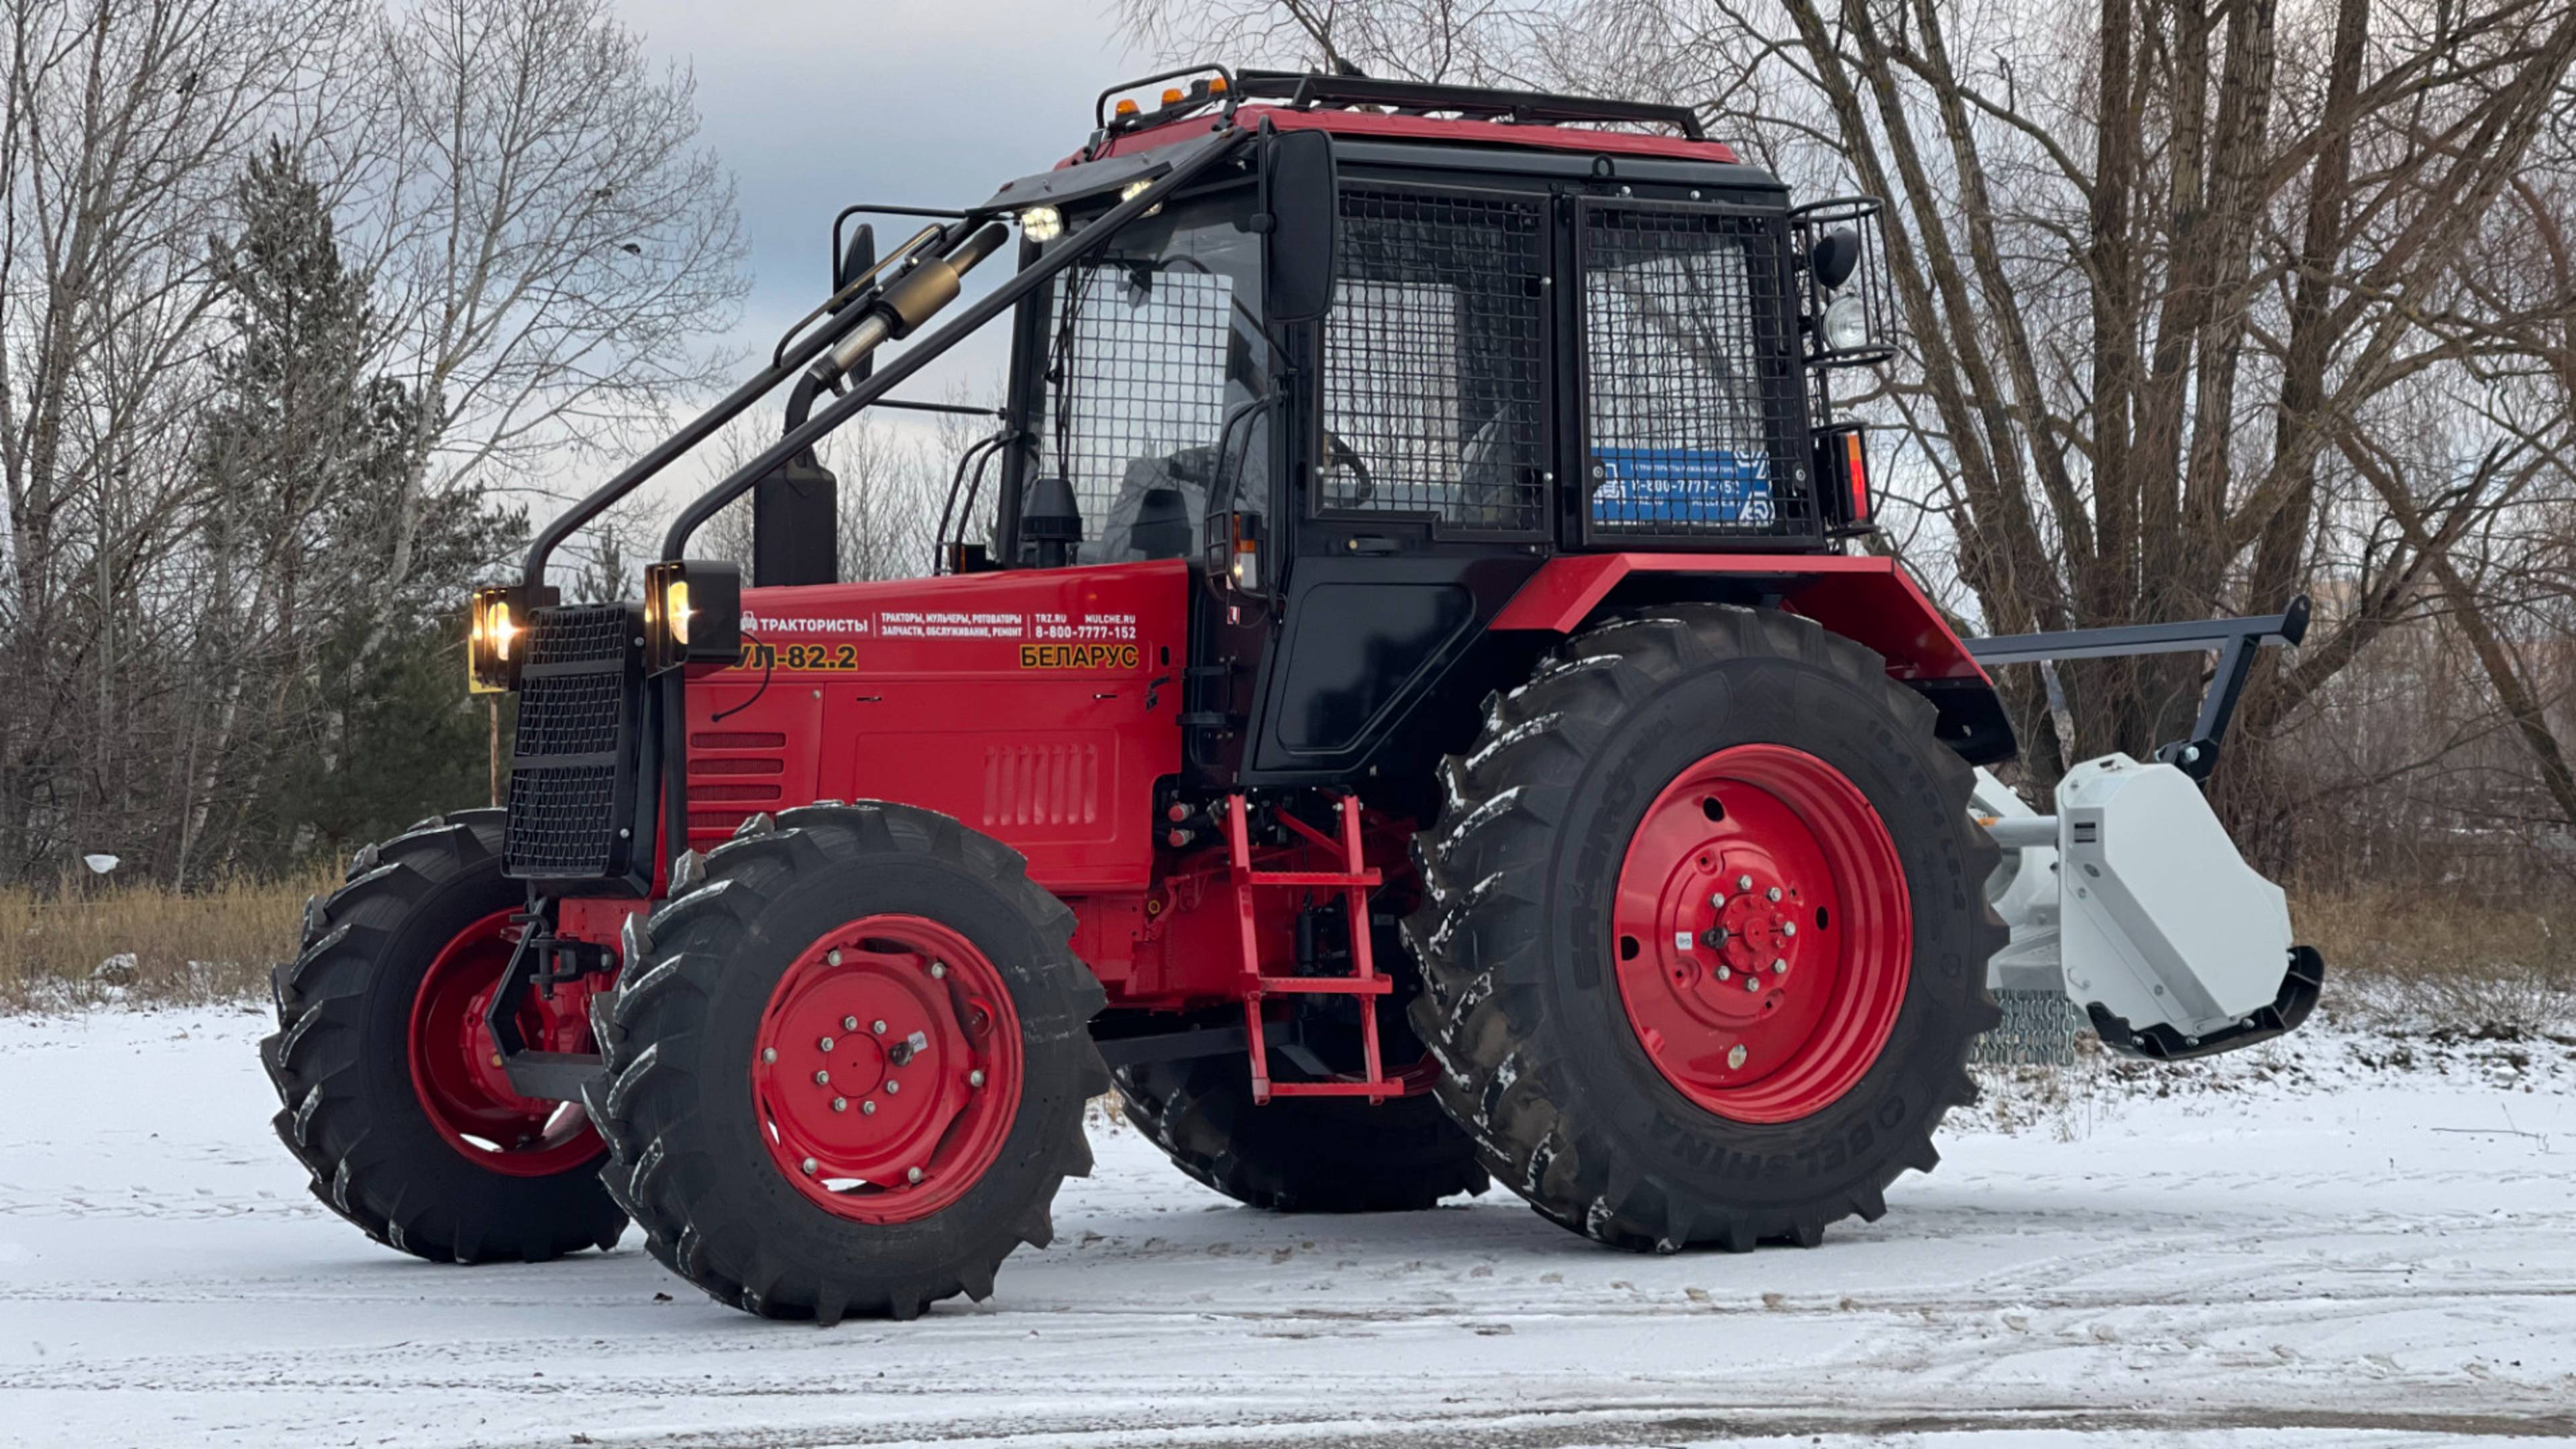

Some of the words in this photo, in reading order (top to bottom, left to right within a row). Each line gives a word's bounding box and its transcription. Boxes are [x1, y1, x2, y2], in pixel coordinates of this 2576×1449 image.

[881, 612, 925, 624] ТРАКТОРЫ,
[926, 613, 971, 625] МУЛЬЧЕРЫ,
[973, 614, 1022, 624] РОТОВАТОРЫ
[1034, 614, 1067, 623] TRZ.RU
[1085, 614, 1136, 624] MULCHE.RU
[760, 619, 868, 632] ТРАКТОРИСТЫ
[881, 625, 925, 637] ЗАПЧАСТИ,
[992, 627, 1022, 637] РЕМОНТ
[1035, 626, 1136, 639] 8-800-7777-152
[1020, 644, 1138, 668] БЕЛАРУС
